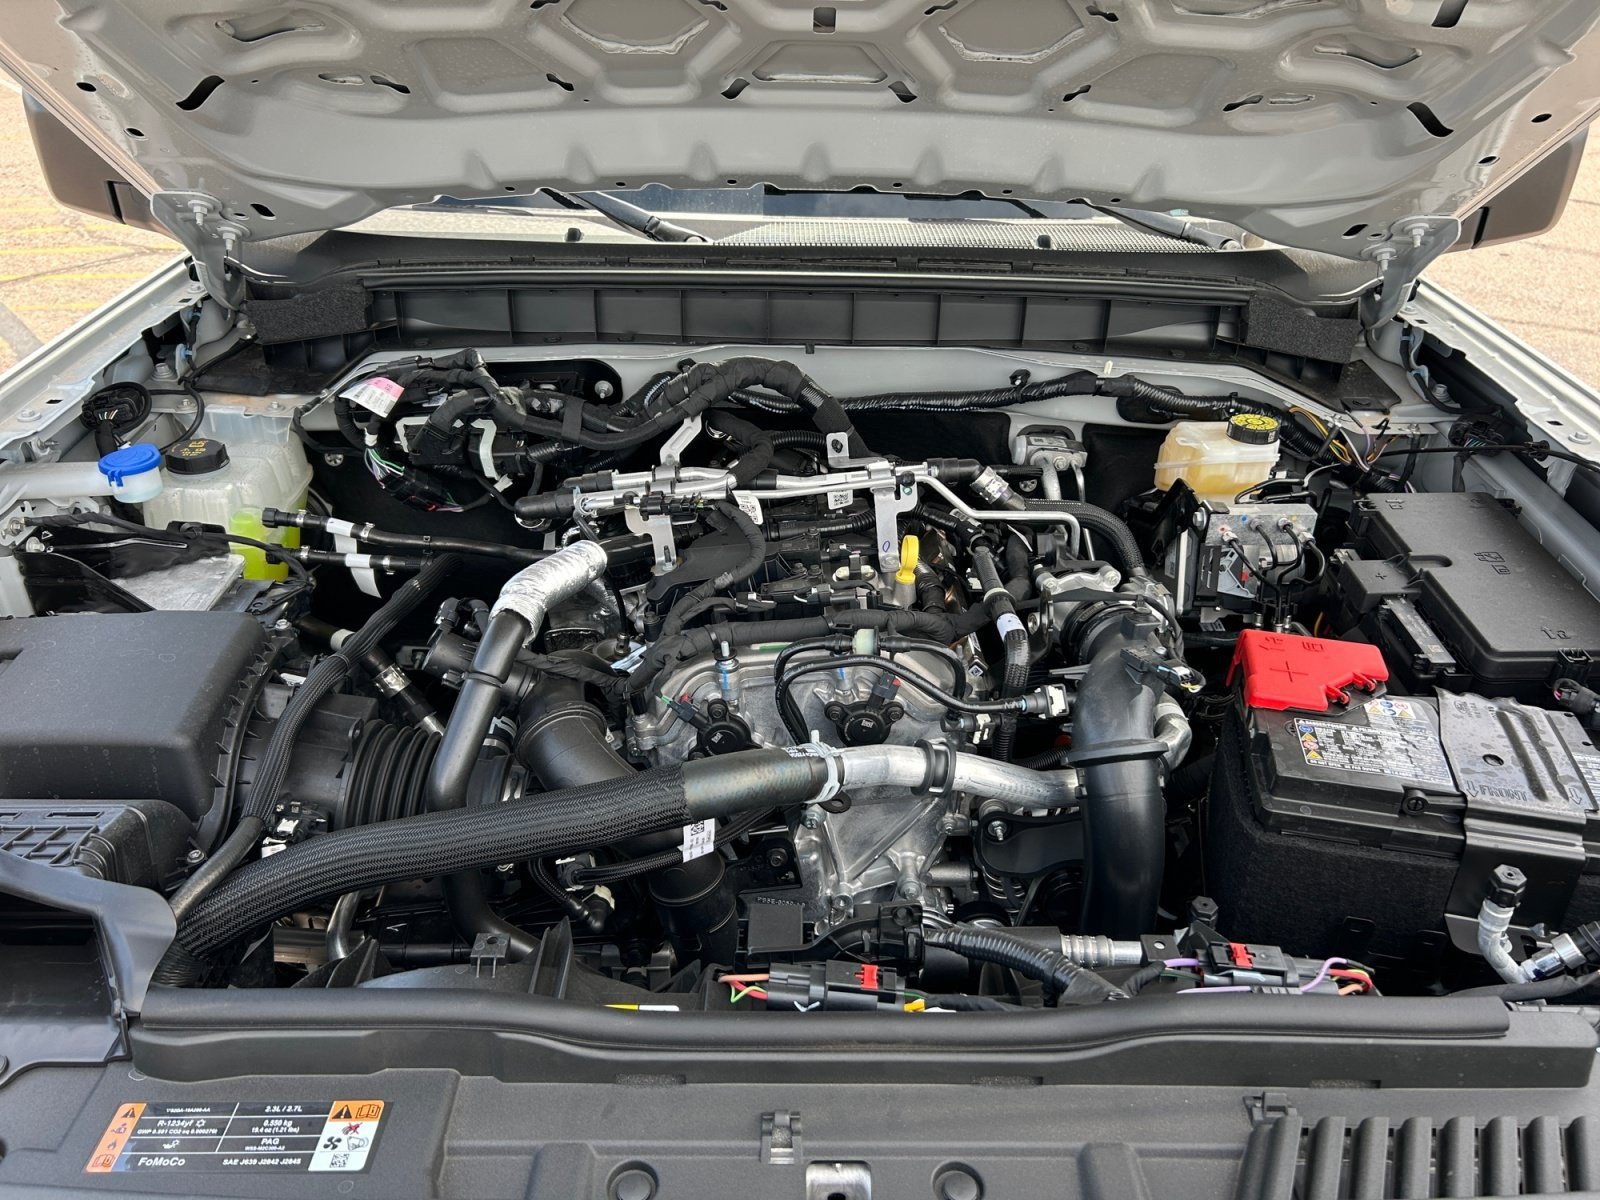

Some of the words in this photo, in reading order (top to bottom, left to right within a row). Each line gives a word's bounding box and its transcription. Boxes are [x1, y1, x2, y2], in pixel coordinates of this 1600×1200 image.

[264, 1105, 281, 1113] 2.3L
[286, 1104, 303, 1112] 2.7L
[156, 1119, 195, 1128] R-1234yf
[260, 1137, 280, 1145] PAG
[137, 1156, 186, 1167] FoMoCo
[222, 1158, 239, 1166] SAE
